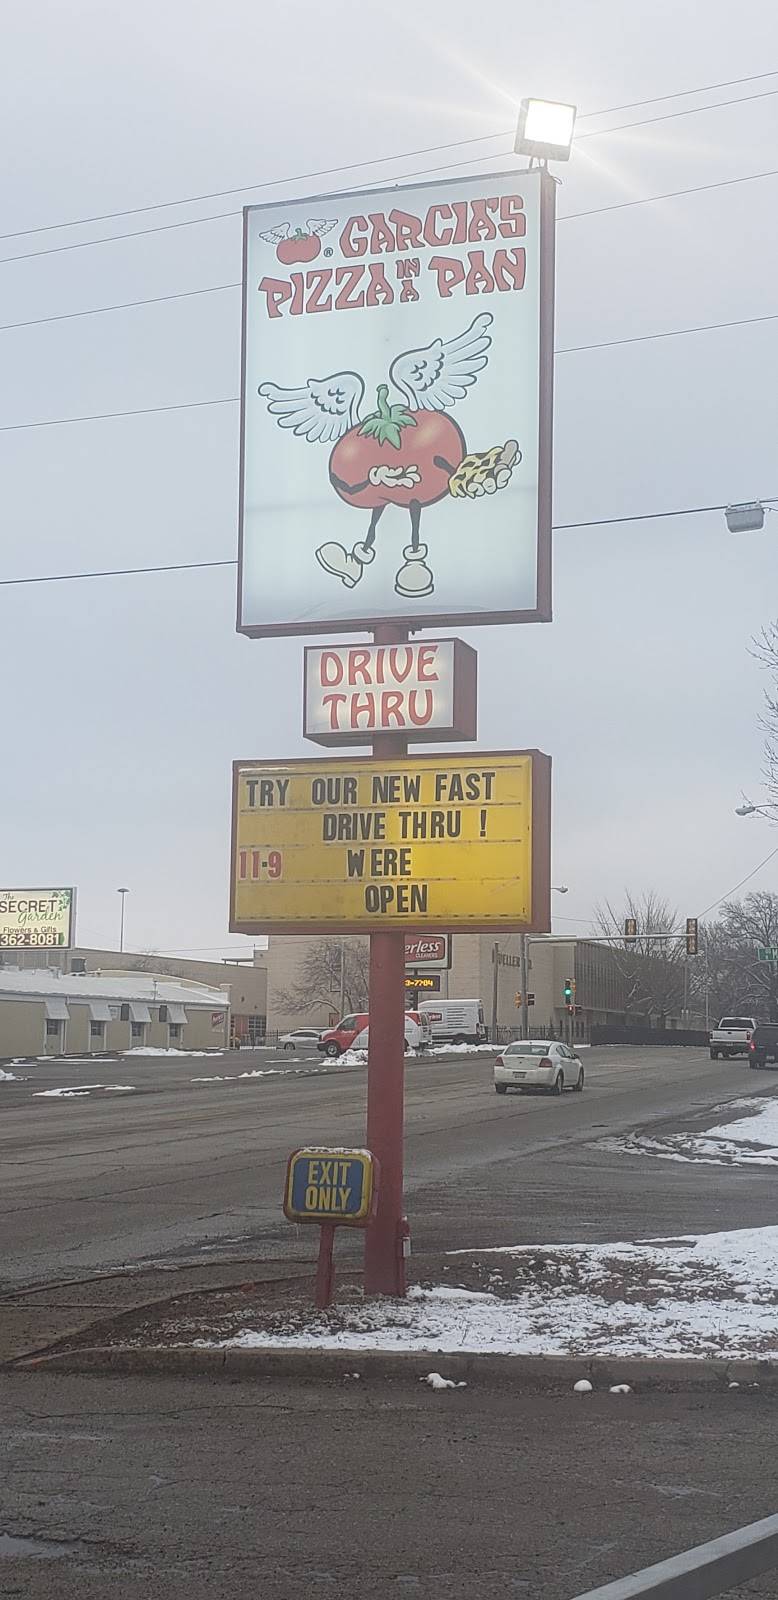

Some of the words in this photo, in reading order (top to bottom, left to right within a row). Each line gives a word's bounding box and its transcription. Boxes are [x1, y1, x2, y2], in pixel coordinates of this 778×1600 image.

[339, 195, 526, 259] GARCIA'S
[395, 258, 421, 280] IN
[428, 247, 526, 298] PAN
[258, 262, 395, 319] PIZZA
[400, 280, 420, 303] A
[320, 645, 439, 687] DRIVE
[322, 689, 434, 730] THRU
[246, 779, 290, 807] TRY
[311, 777, 358, 805] OUR
[372, 775, 420, 803] NEW
[435, 772, 496, 801] FAST
[323, 812, 386, 841] DRIVE
[399, 810, 461, 839] THRU
[479, 809, 487, 837] !
[347, 848, 412, 877] WERE
[0, 900, 57, 913] SECRET
[364, 884, 428, 914] OPEN
[17, 906, 63, 927] Garden
[0, 933, 60, 946] 362-8081
[308, 1161, 352, 1186] EXIT
[305, 1185, 352, 1211] ONLY
